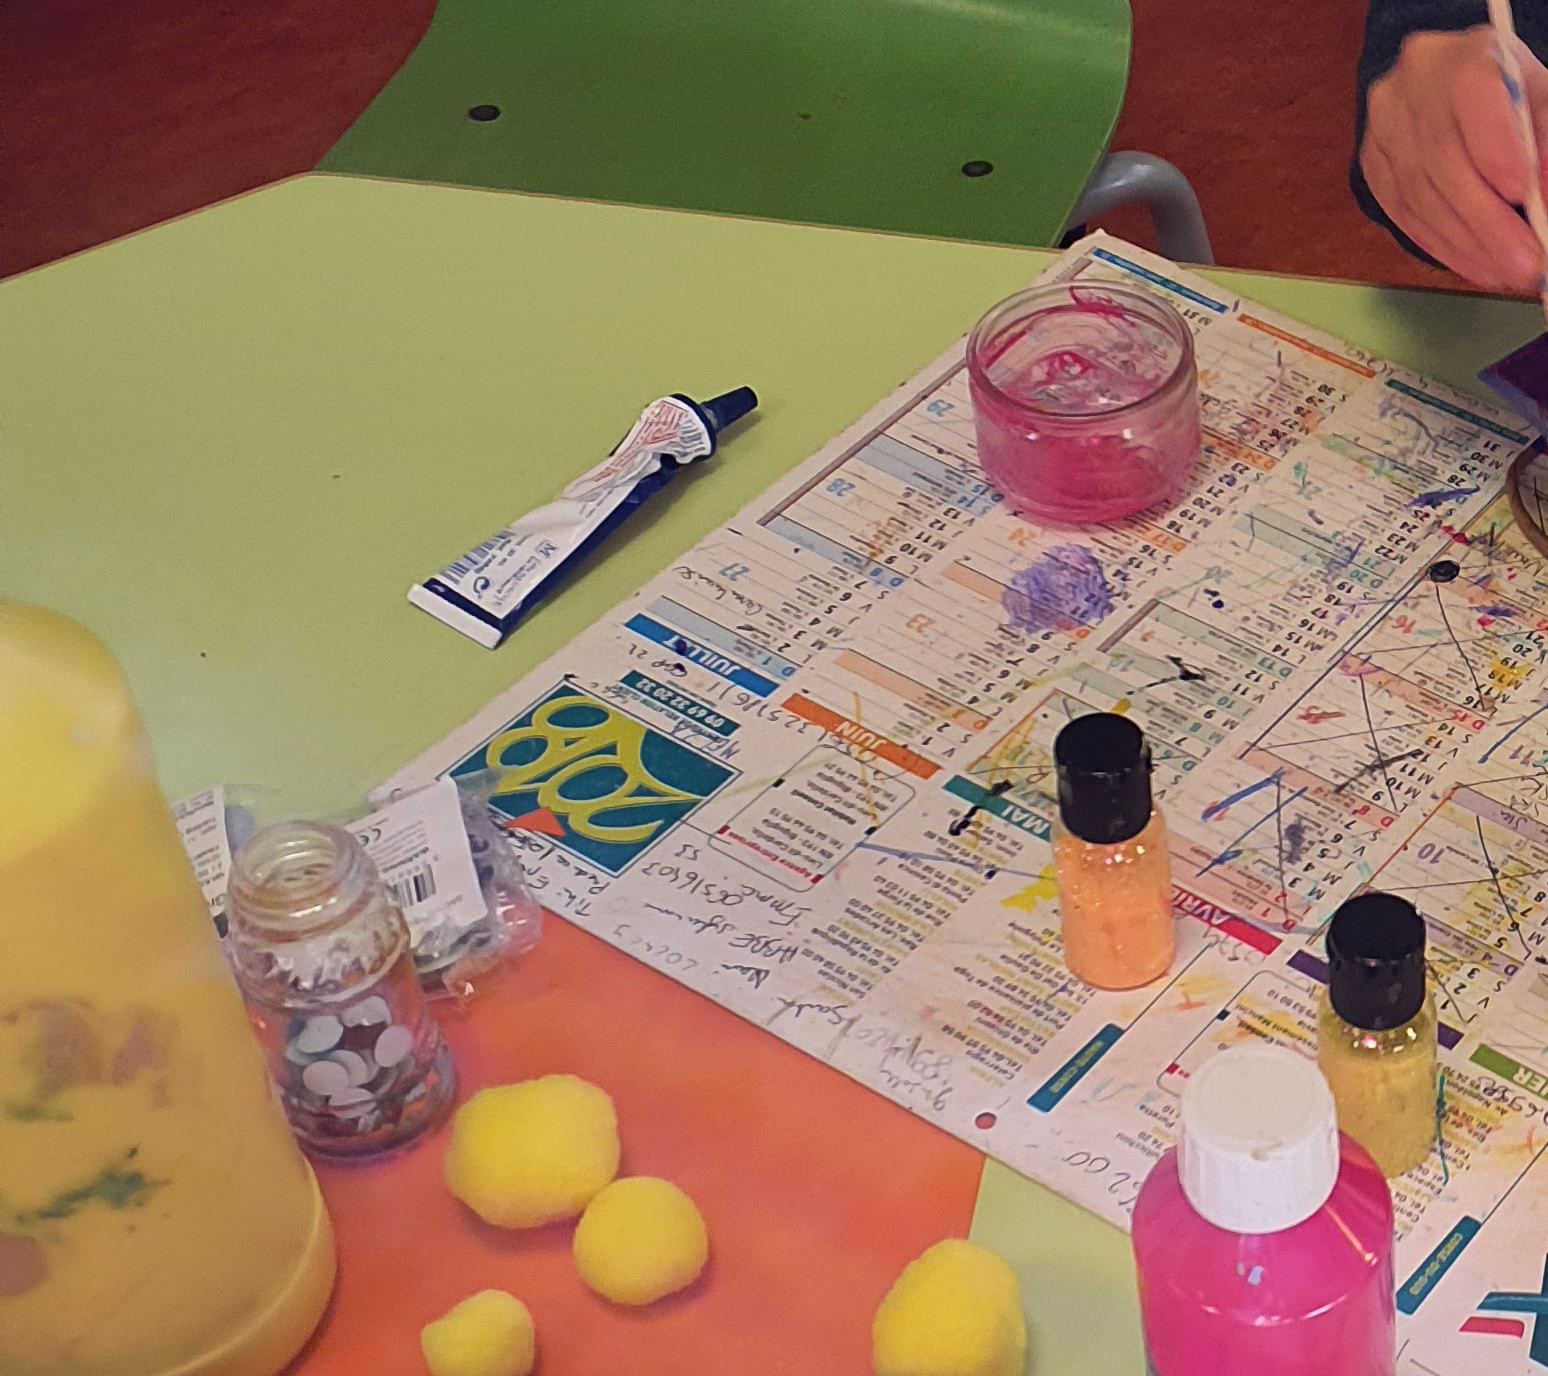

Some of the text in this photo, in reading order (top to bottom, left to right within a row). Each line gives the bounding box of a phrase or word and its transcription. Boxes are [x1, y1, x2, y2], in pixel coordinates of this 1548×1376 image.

[923, 397, 956, 417] 29
[823, 476, 857, 497] 28
[716, 559, 752, 582] 27
[854, 580, 889, 600] S 7
[839, 592, 872, 613] V 6
[824, 604, 860, 625] J 5
[901, 612, 936, 635] 23
[1387, 613, 1421, 636] 16
[808, 617, 844, 638] M 4
[793, 630, 828, 651] M 3
[633, 677, 658, 693] 32
[650, 686, 675, 702] 20
[667, 694, 692, 711] 32
[684, 703, 710, 720] 69
[702, 711, 728, 729] 09
[832, 718, 889, 753] JUIN
[1507, 743, 1539, 767] 11
[486, 694, 711, 842] 2018
[998, 802, 1052, 836] MAI
[1413, 839, 1450, 867] 10
